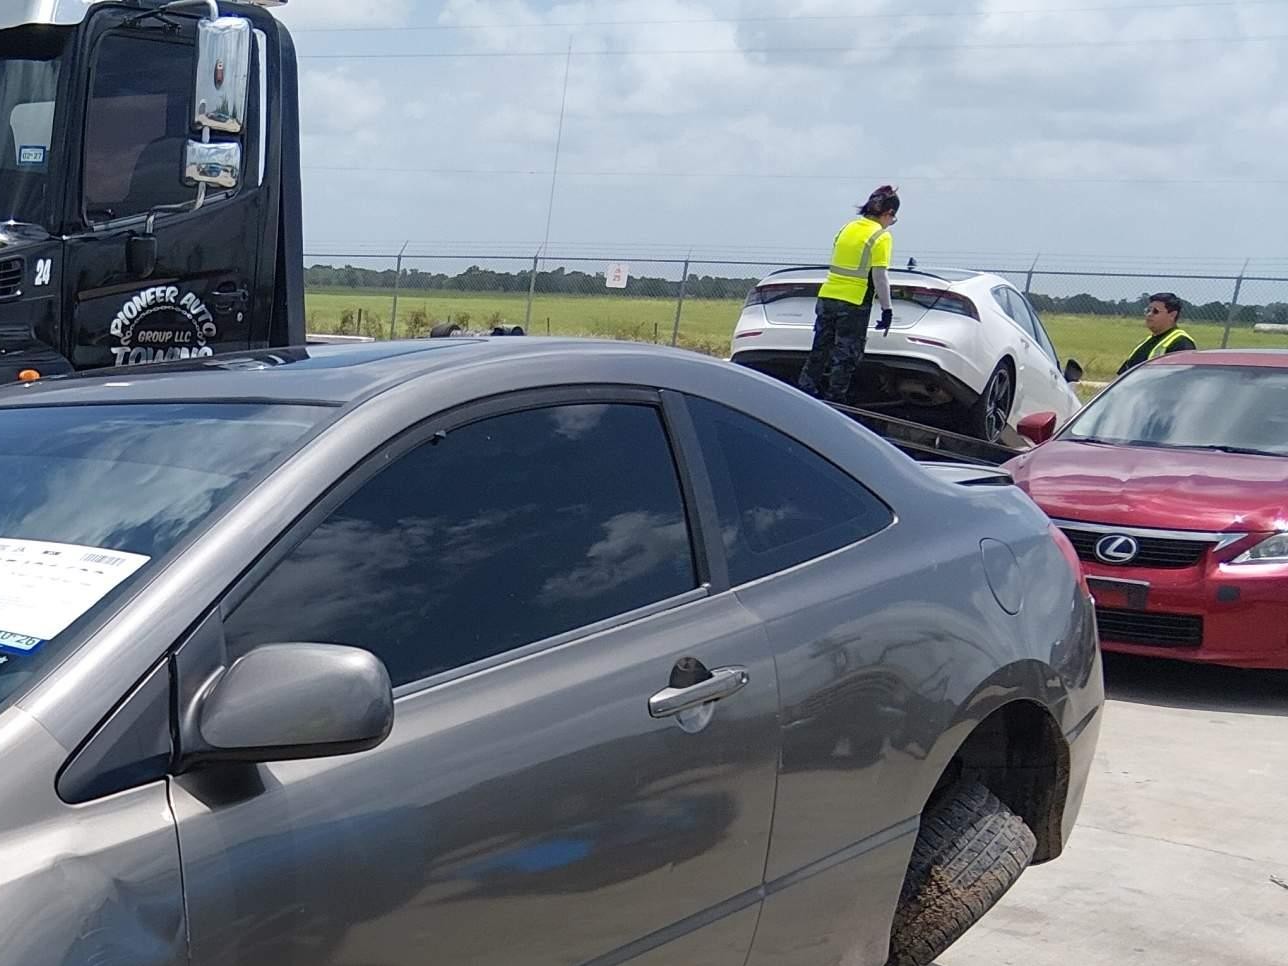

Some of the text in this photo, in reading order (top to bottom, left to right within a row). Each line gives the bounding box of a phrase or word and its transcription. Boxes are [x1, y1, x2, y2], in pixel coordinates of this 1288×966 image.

[34, 258, 52, 286] 24
[110, 286, 217, 338] PIONEER AUTO
[138, 330, 192, 343] GROUP LLC
